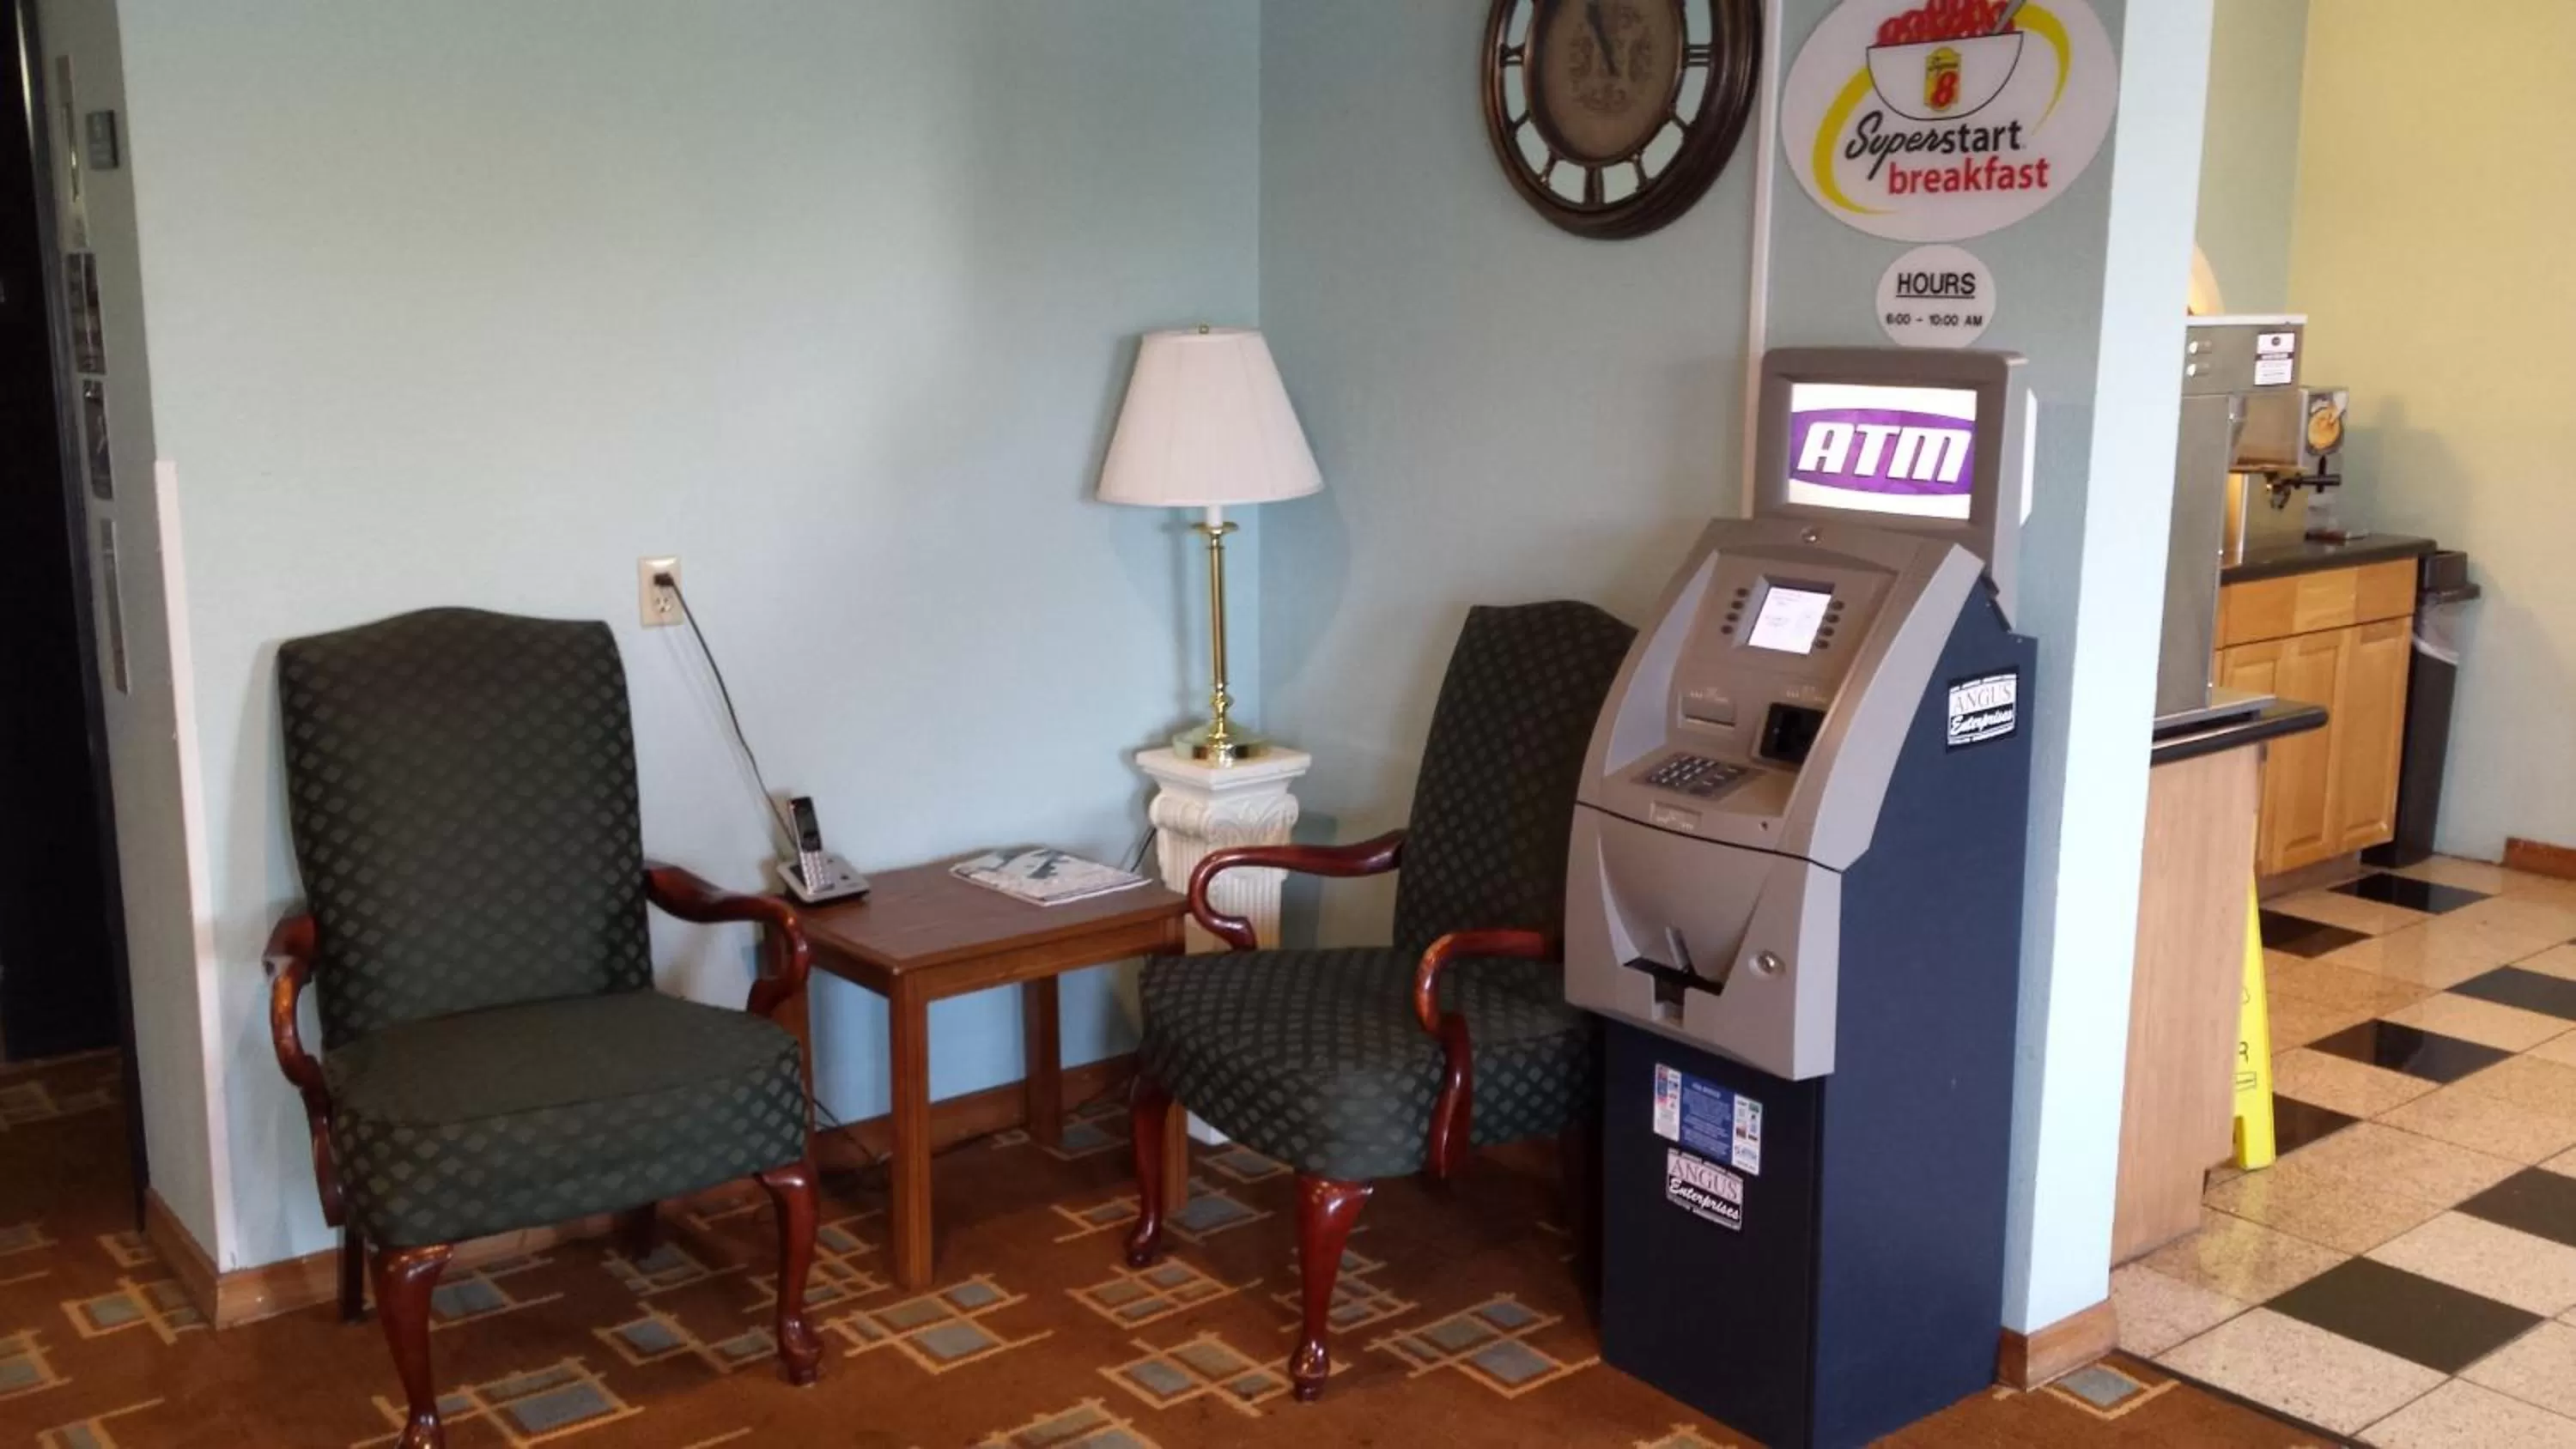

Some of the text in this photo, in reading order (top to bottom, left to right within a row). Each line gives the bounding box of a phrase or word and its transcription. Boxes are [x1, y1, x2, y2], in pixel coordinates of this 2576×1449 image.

[1930, 70, 1959, 109] 8
[1844, 110, 2023, 180] Superstart
[1888, 156, 2050, 195] breakfast
[1897, 271, 1976, 294] HOURS
[1929, 313, 1959, 326] 10:00
[1965, 314, 1983, 326] AM
[1797, 421, 1972, 483] ATM
[1953, 684, 2012, 712] ANGUS
[1669, 1178, 1741, 1220] Enterprises
[1670, 1159, 1739, 1202] ANGUS
